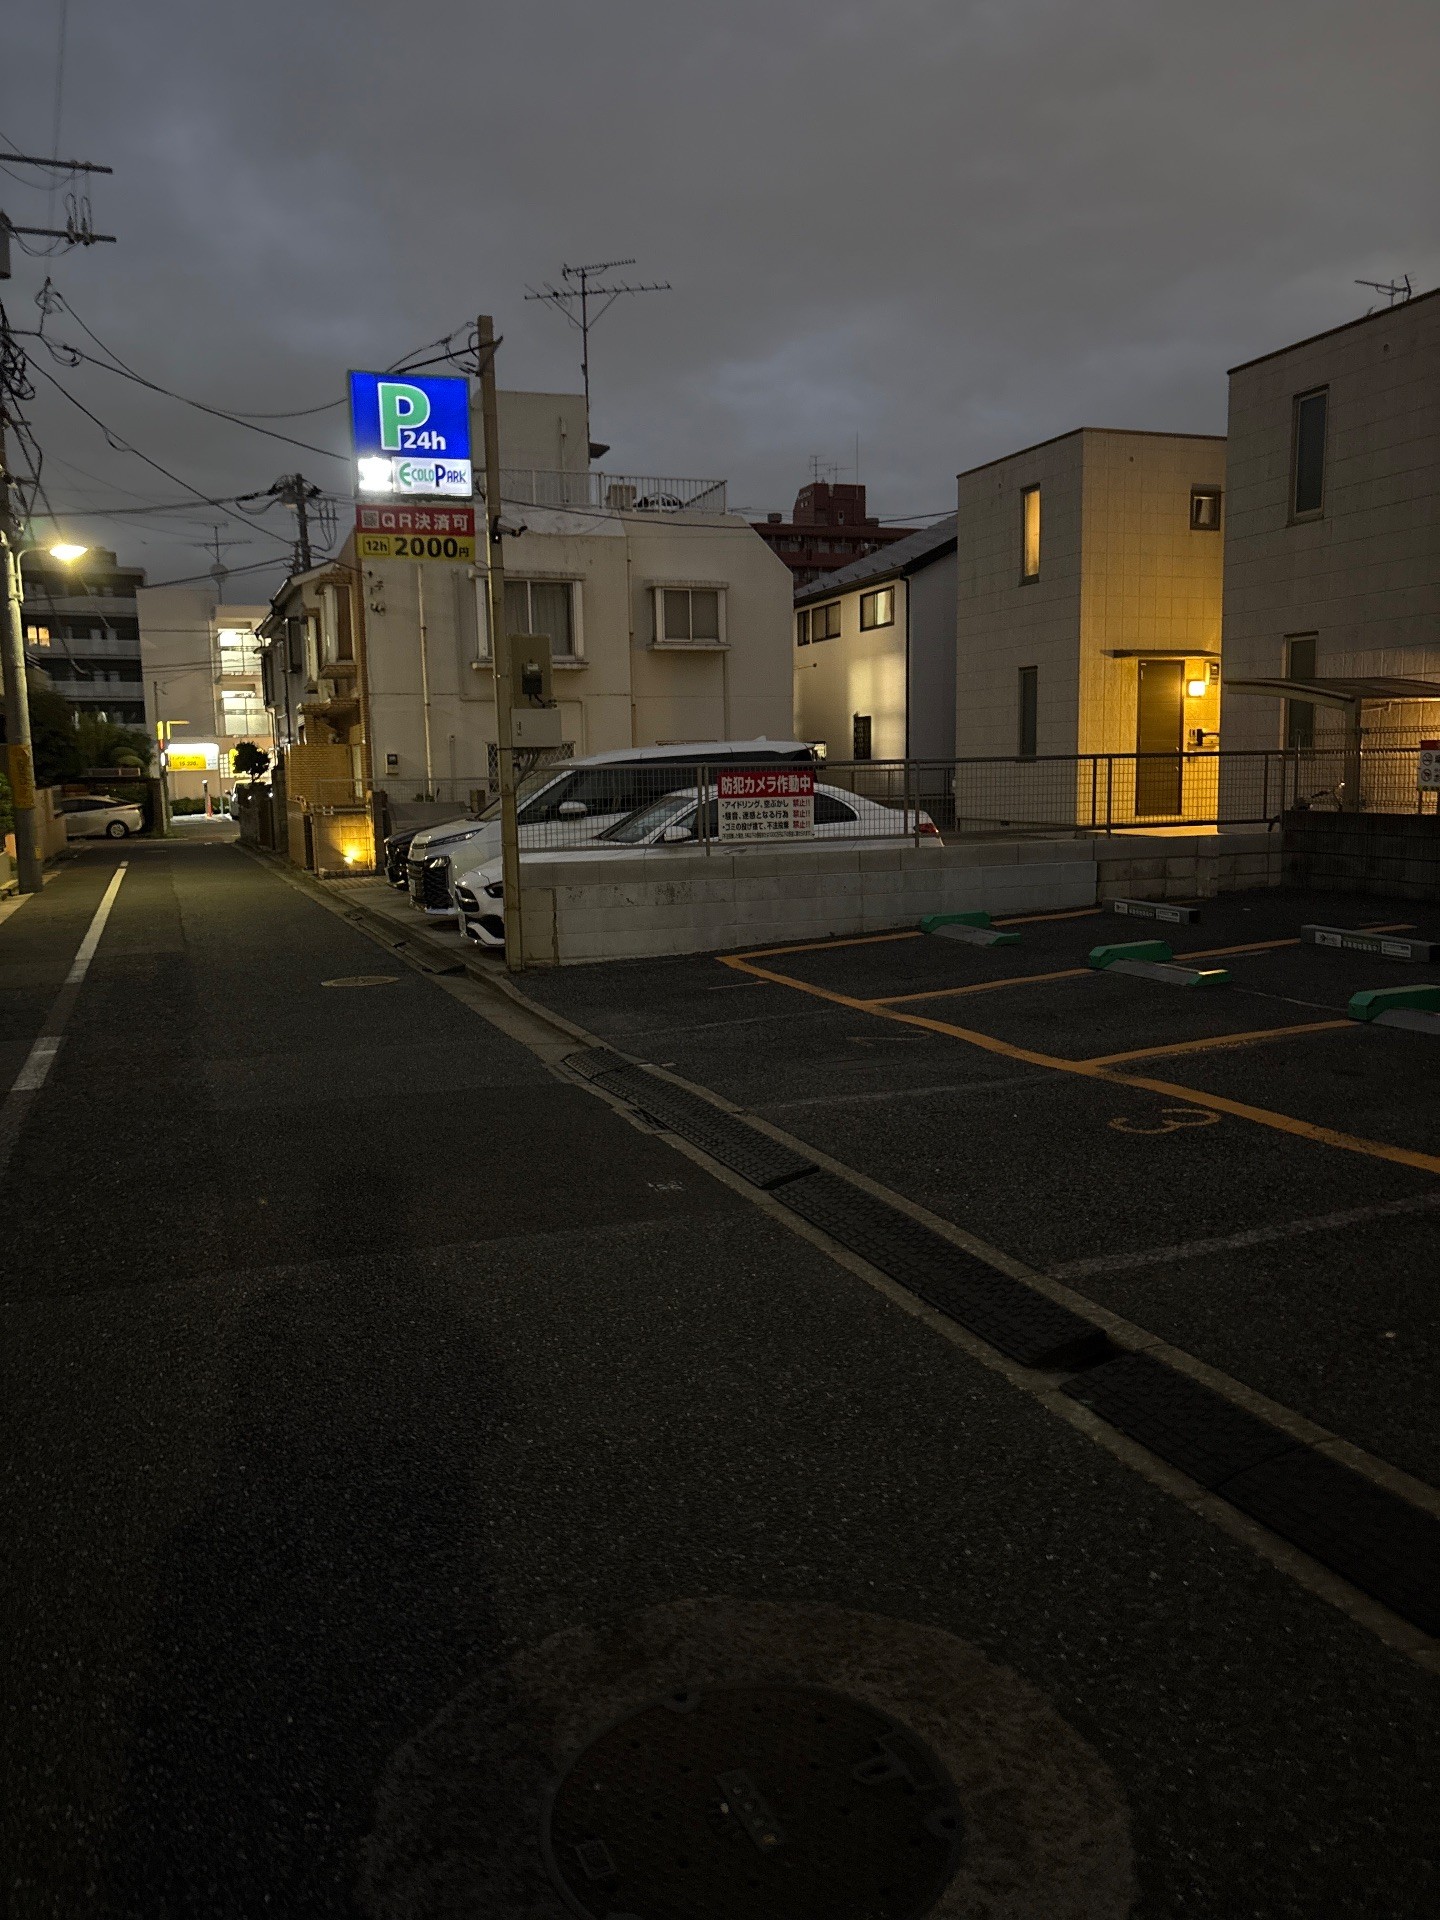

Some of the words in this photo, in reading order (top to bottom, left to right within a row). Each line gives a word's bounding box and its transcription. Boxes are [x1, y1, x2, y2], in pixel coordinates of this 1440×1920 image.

[377, 381, 431, 451] P
[403, 430, 447, 452] 24h
[381, 512, 469, 531] QR決済可
[366, 540, 388, 552] 12h
[721, 774, 811, 795] 防犯カメラ作動中
[1107, 1107, 1221, 1135] 3
